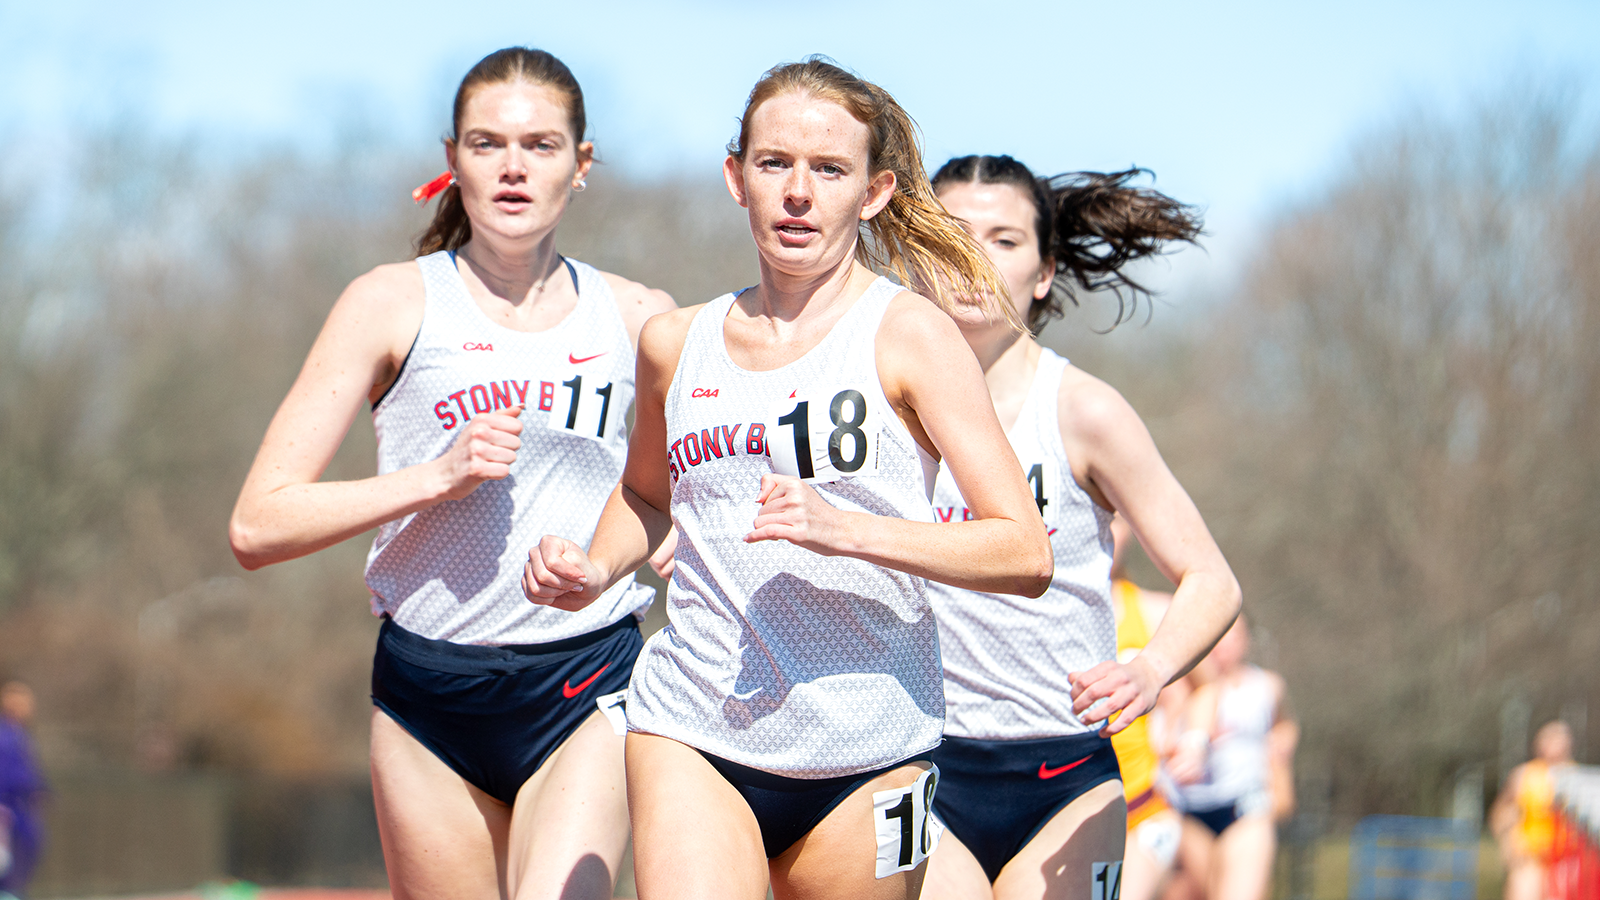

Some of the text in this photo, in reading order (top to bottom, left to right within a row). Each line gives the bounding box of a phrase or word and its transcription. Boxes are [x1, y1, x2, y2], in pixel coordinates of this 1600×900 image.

[462, 341, 494, 352] CAA
[434, 379, 530, 430] STONY
[562, 374, 614, 439] 11
[691, 387, 720, 398] CAA
[668, 423, 742, 483] STONY
[778, 389, 868, 480] 18
[1027, 463, 1049, 518] 4
[885, 772, 936, 868] 18
